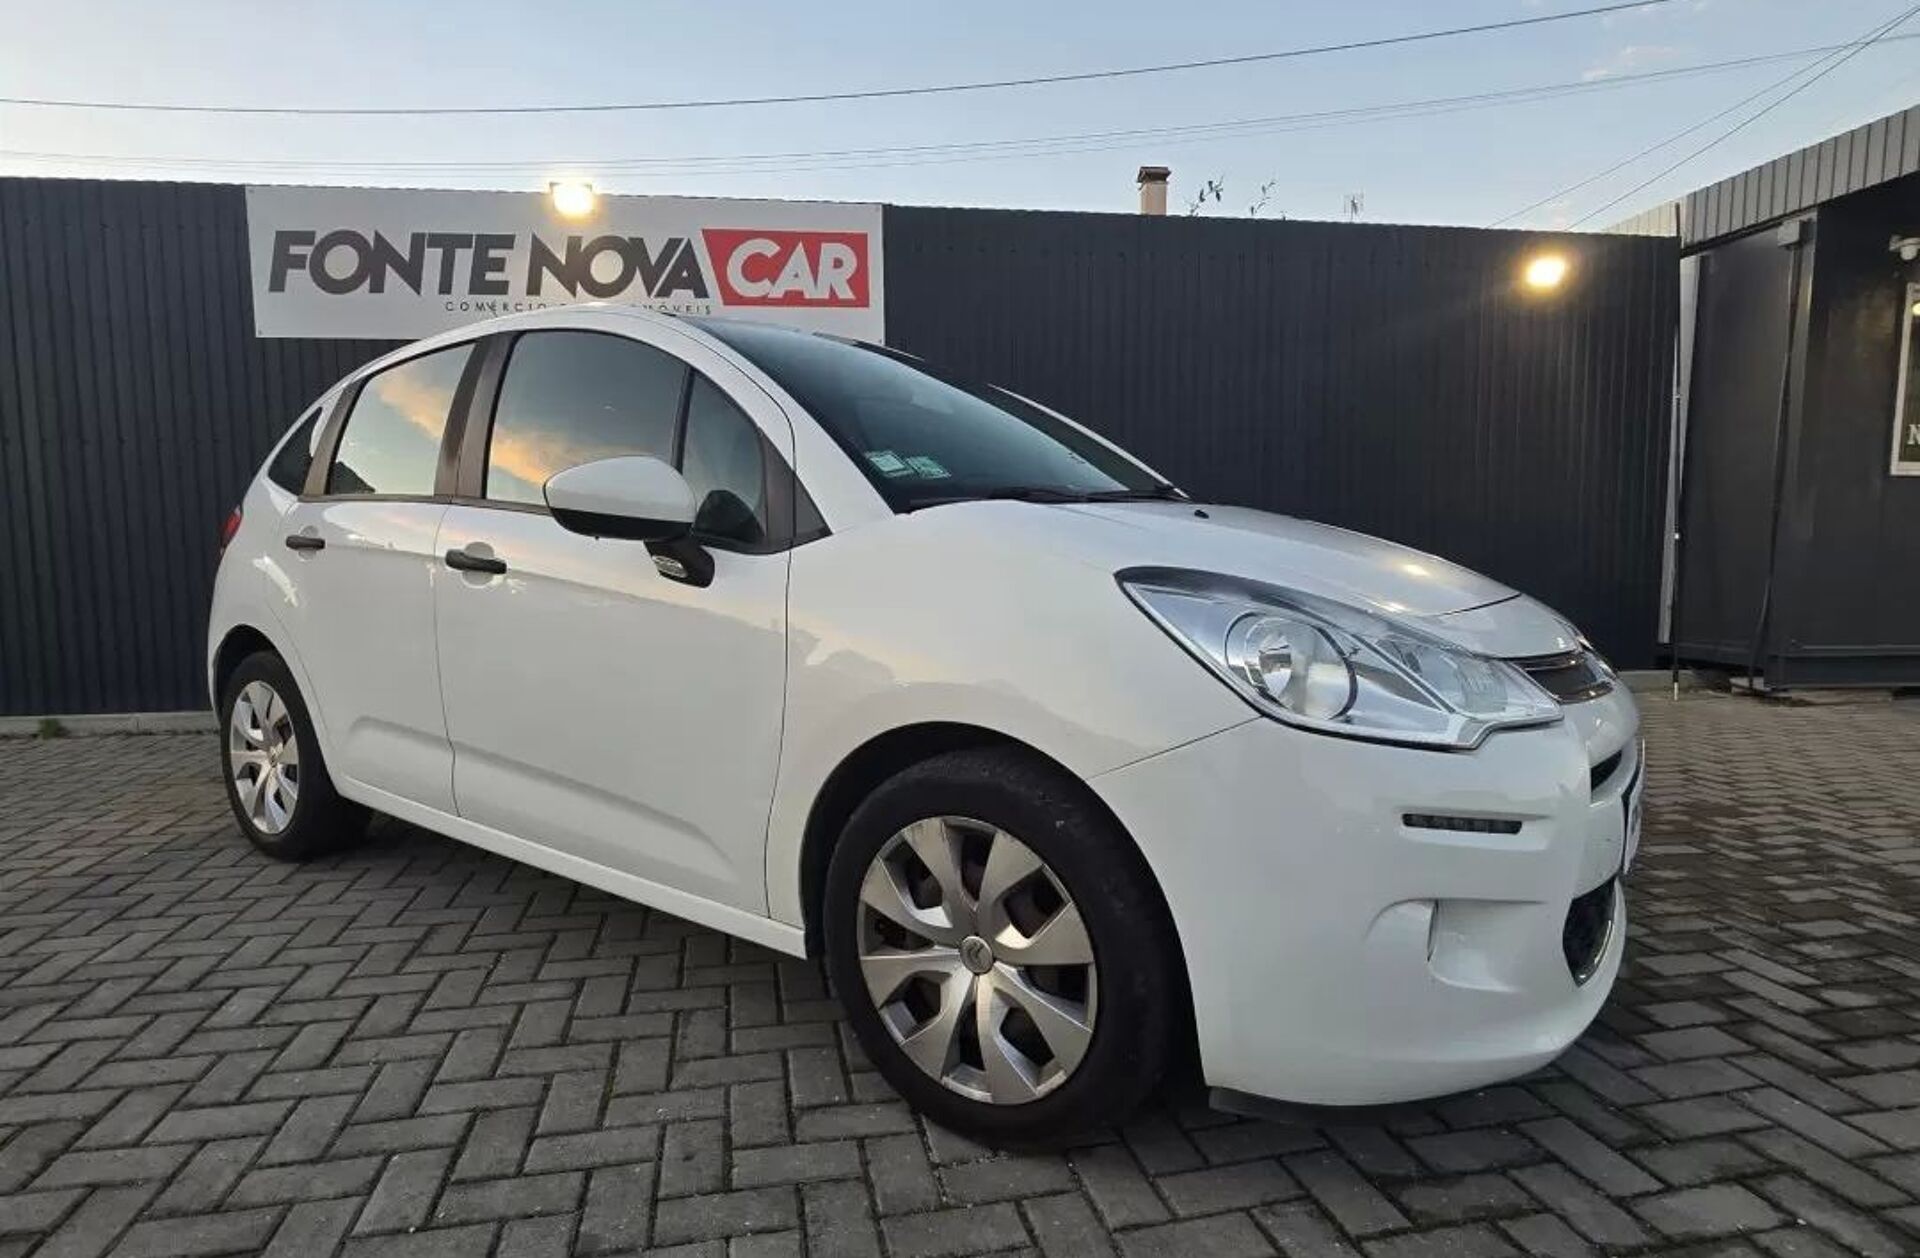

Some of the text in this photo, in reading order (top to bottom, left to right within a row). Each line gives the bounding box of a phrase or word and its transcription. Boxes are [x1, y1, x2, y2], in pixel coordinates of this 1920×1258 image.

[268, 229, 857, 301] FONTE NOVA CAR
